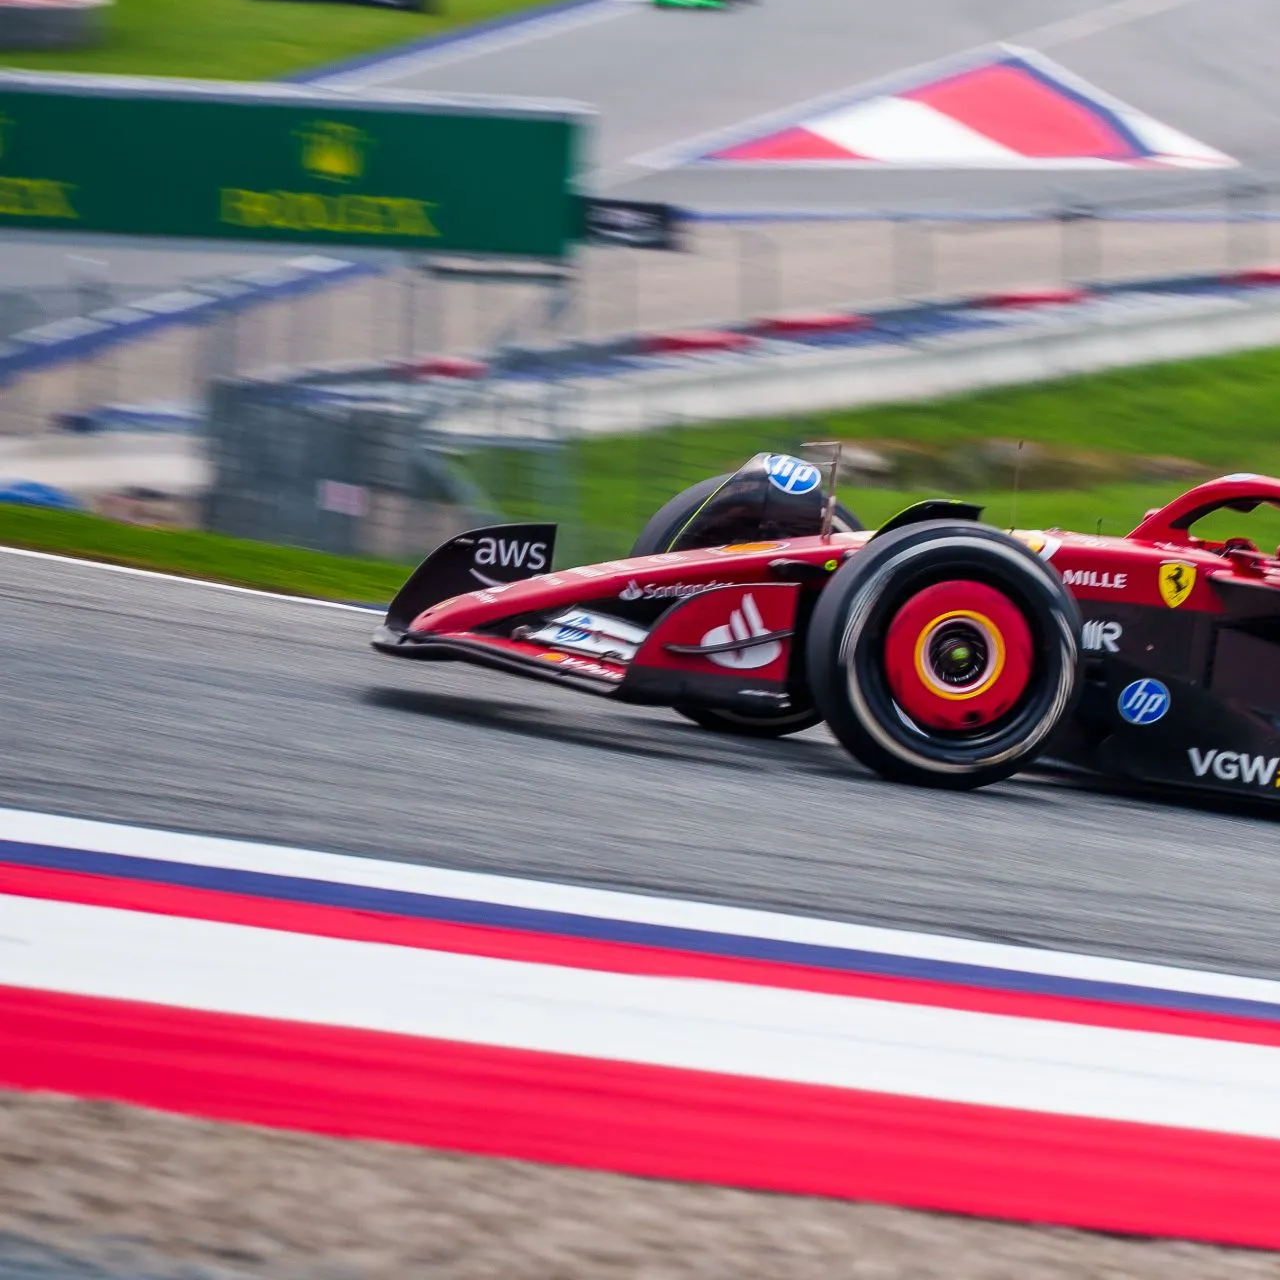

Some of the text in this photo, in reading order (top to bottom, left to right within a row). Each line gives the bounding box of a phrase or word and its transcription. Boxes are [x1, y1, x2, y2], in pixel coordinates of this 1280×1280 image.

[769, 455, 817, 493] hp
[475, 537, 548, 570] aws
[1062, 569, 1128, 589] MILLE
[1122, 678, 1168, 725] hp
[1187, 748, 1280, 786] VGW
